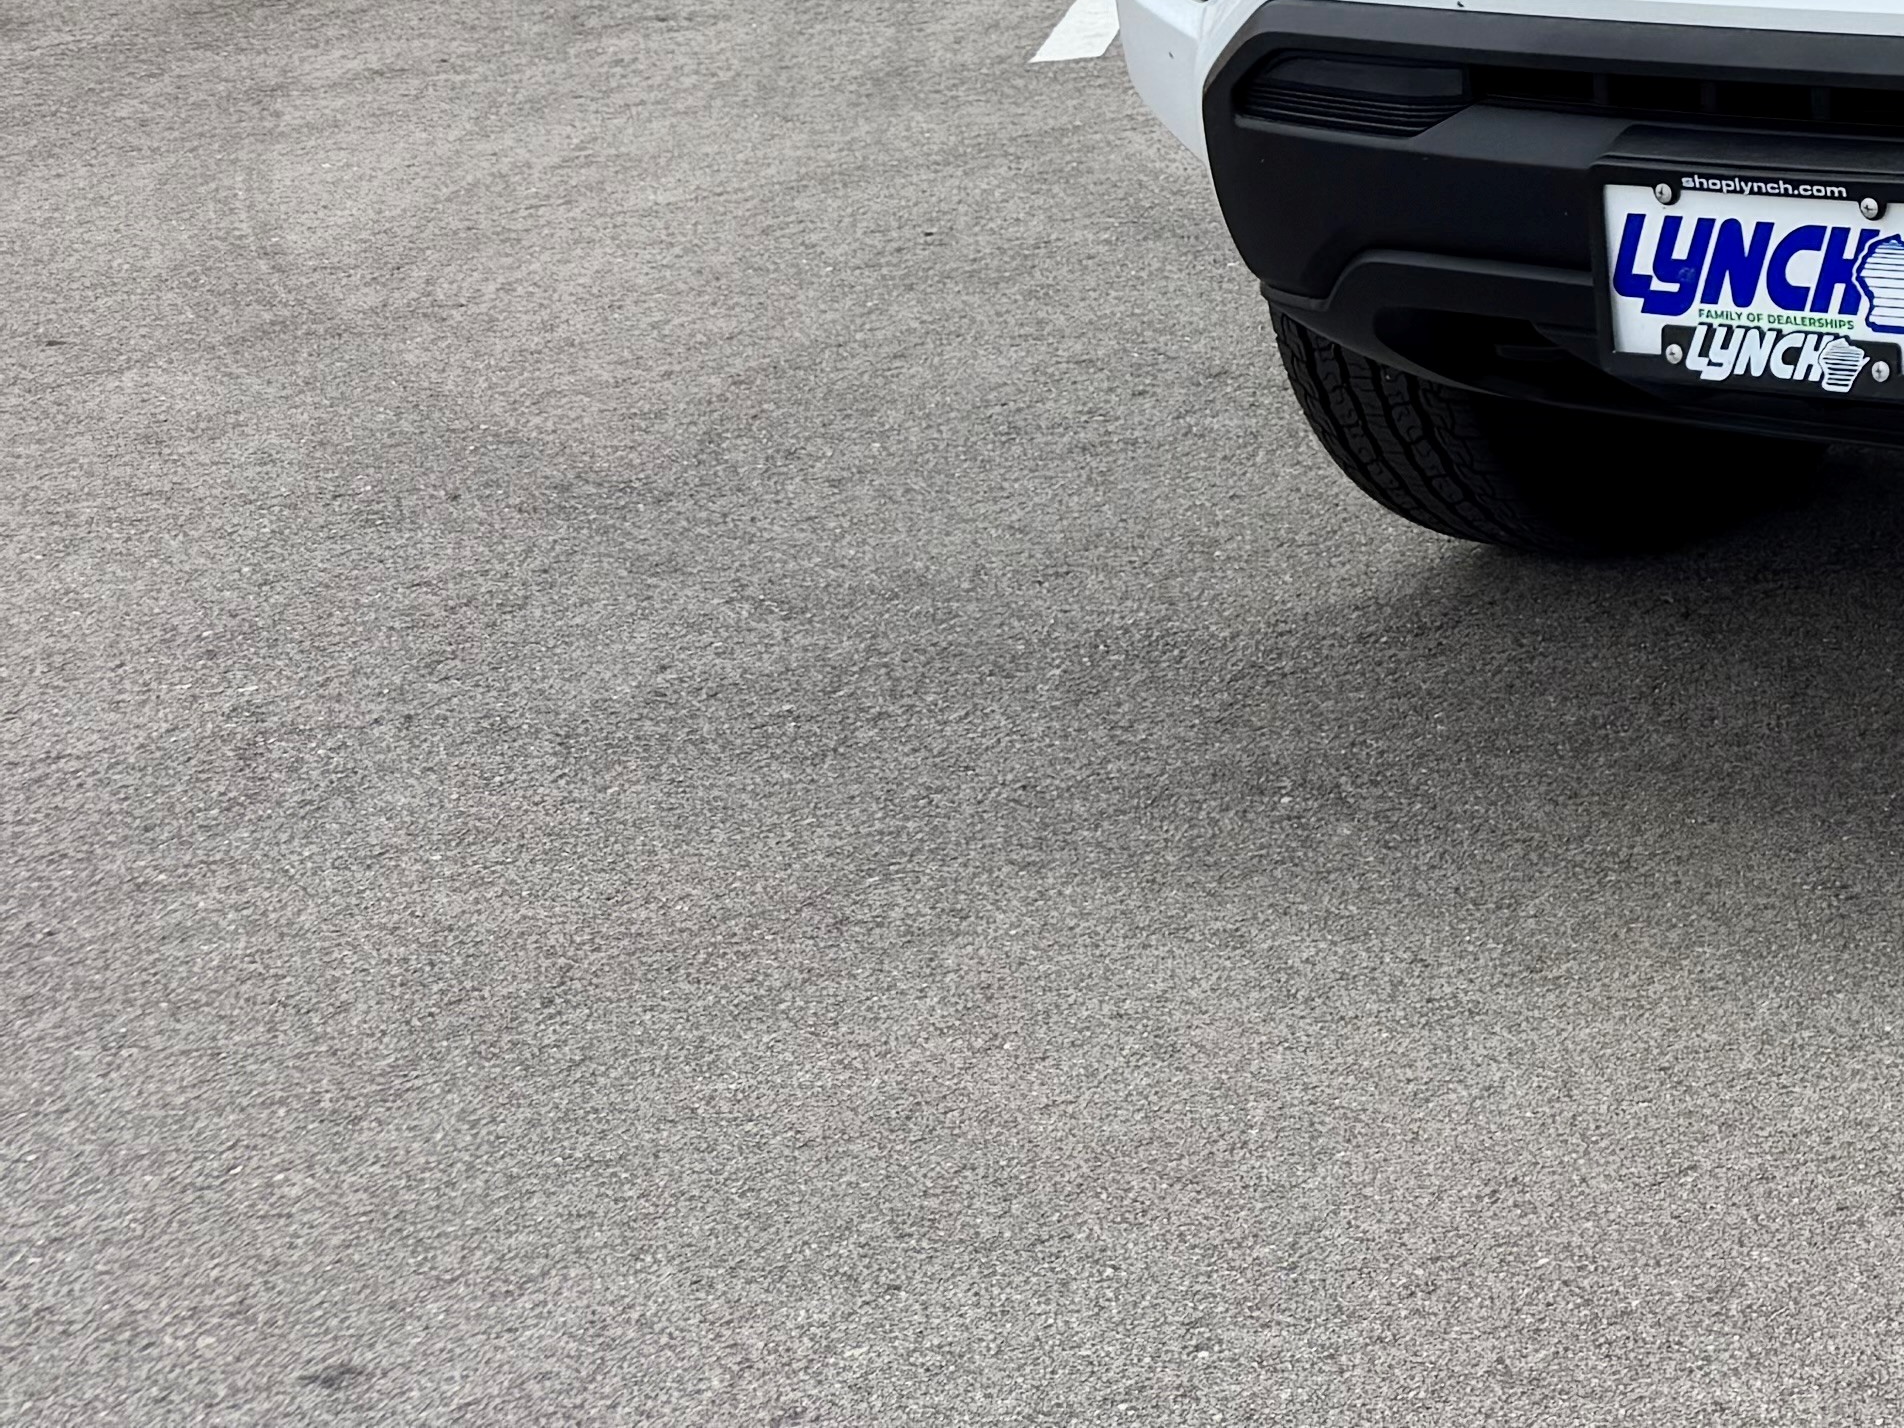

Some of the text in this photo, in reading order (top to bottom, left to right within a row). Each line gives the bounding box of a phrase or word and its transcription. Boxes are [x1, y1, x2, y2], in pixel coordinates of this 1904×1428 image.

[1681, 174, 1848, 198] shoplynch.com
[1612, 212, 1881, 317] LYNCH
[1698, 308, 1855, 330] FAMILY OF DEALERSHIPS
[1686, 323, 1838, 382] LYNCH
